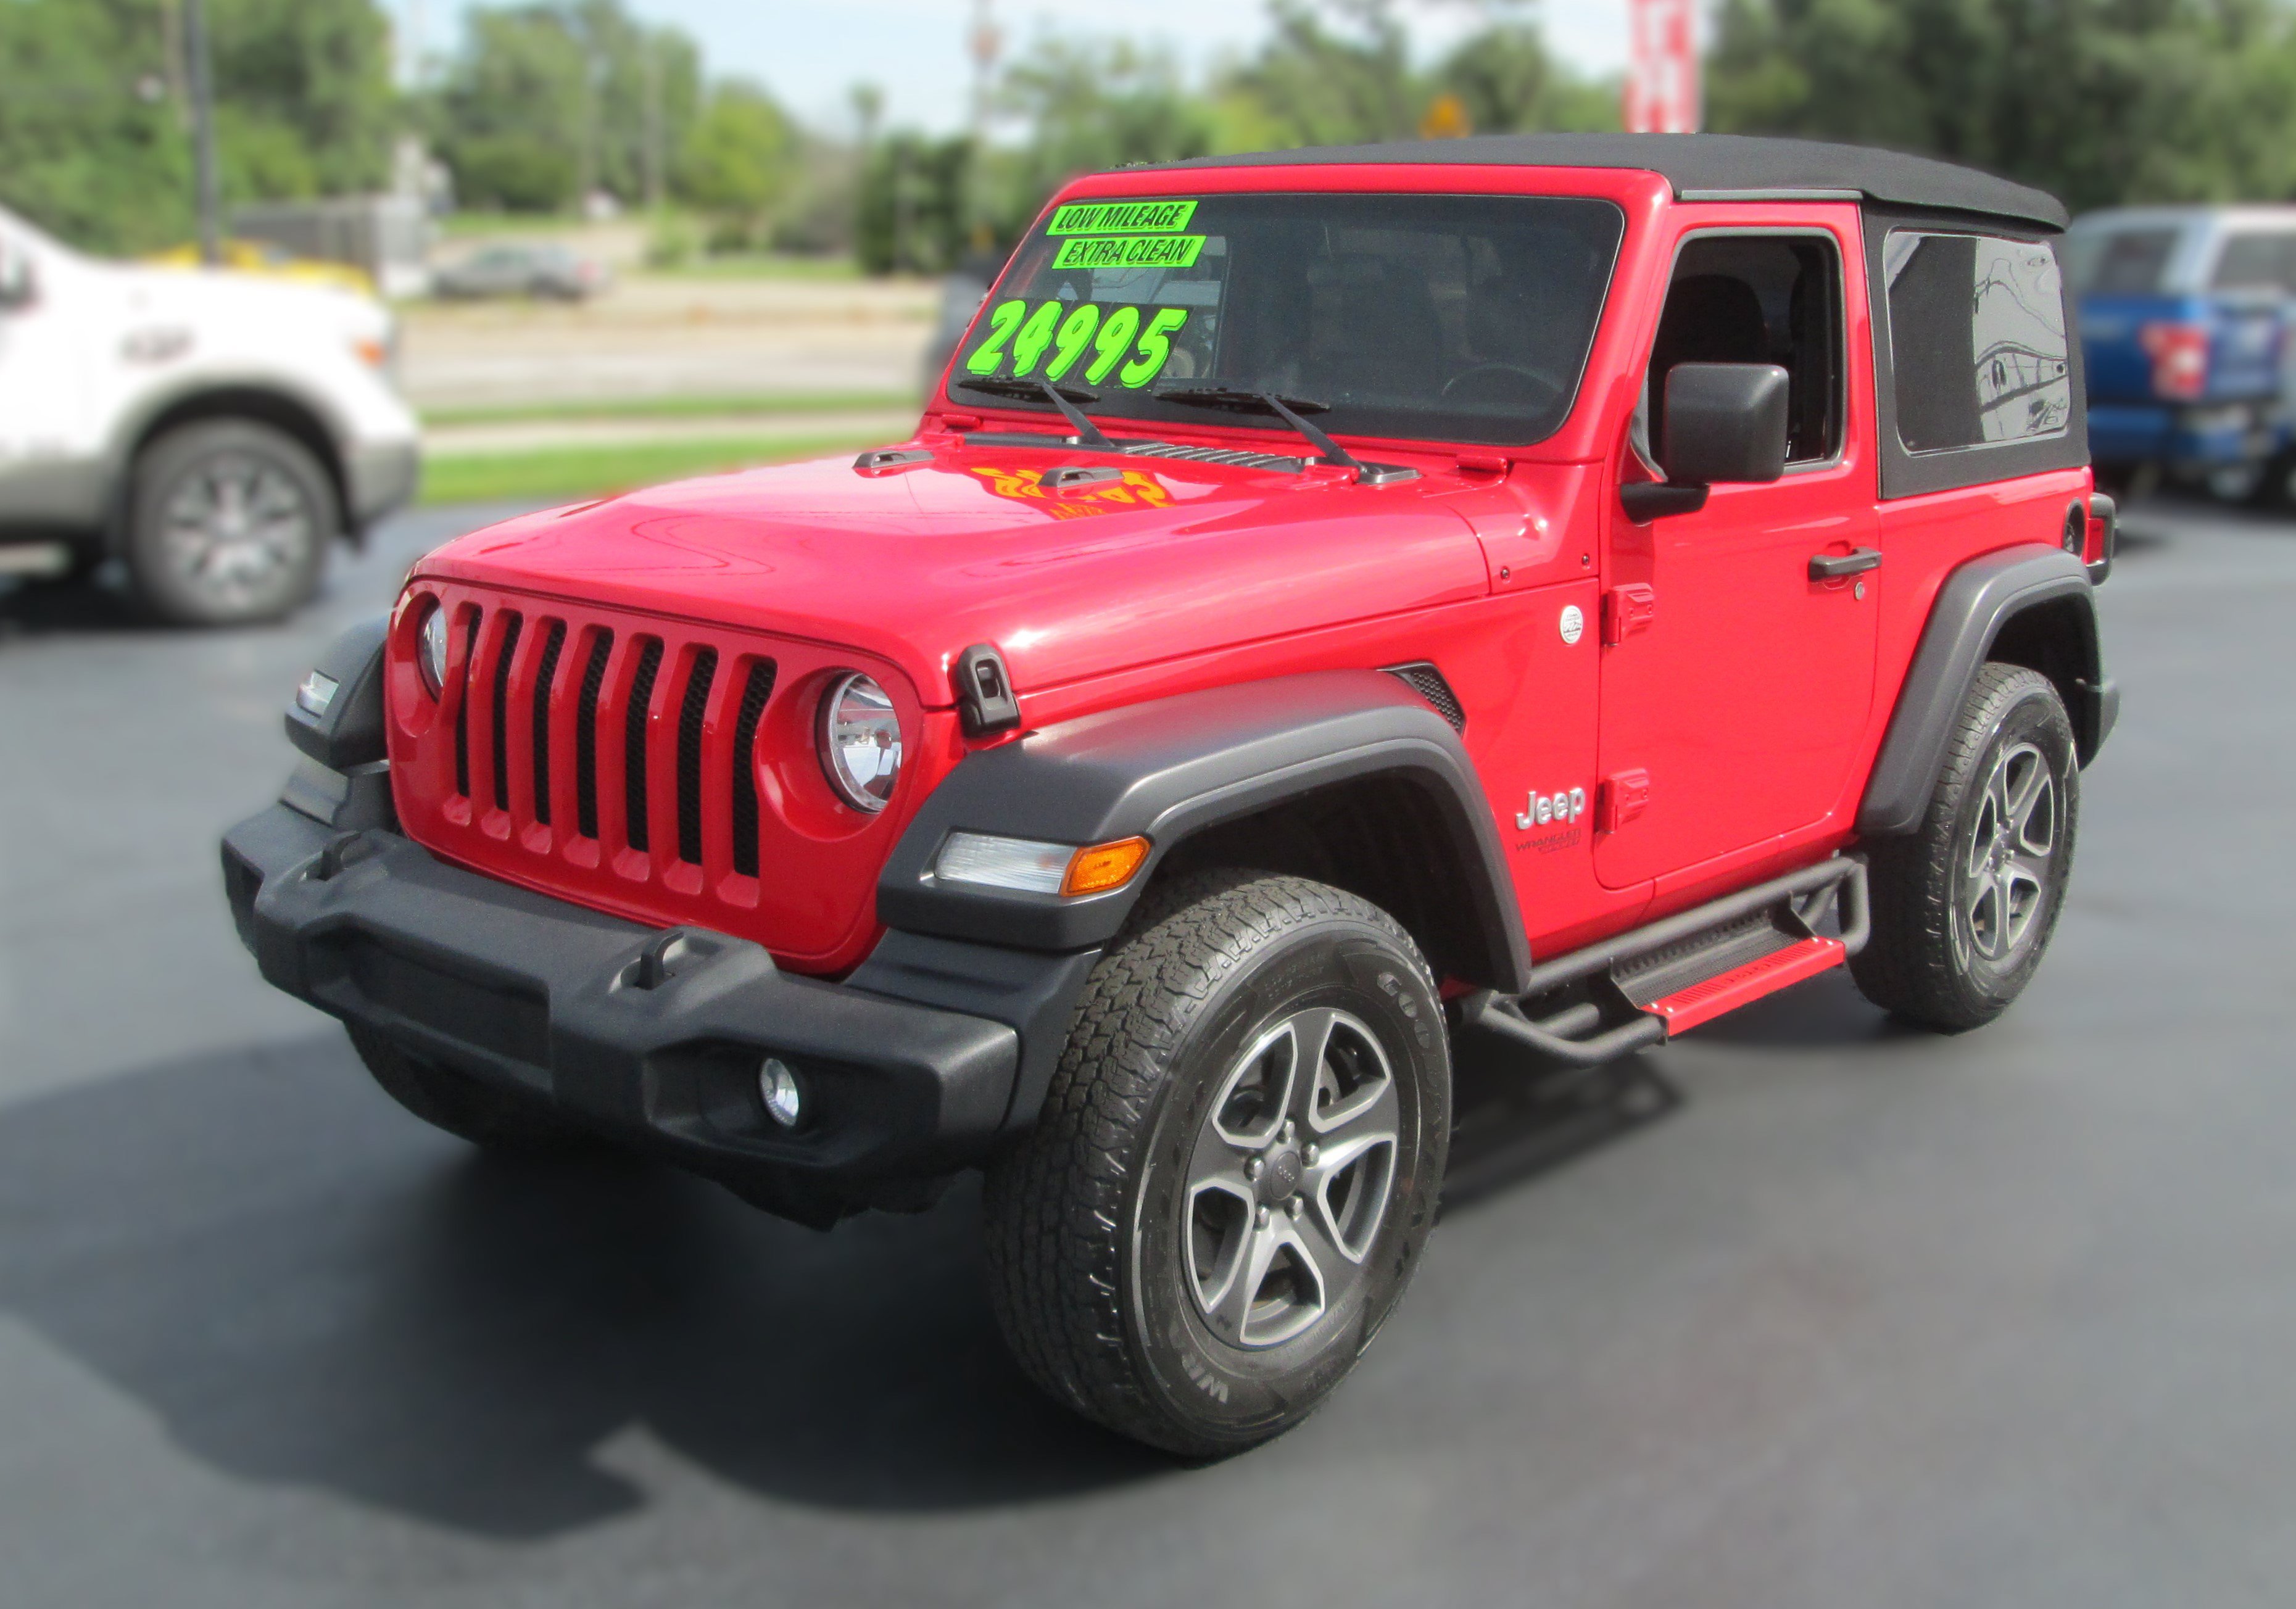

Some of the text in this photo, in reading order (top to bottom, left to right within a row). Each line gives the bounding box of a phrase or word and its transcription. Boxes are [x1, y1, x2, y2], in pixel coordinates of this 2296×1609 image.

[1056, 204, 1187, 231] LOW MILEAGE
[1063, 238, 1195, 266] EXTRA CLEAN
[966, 300, 1188, 389] 24995
[1515, 787, 1586, 830] Jeep
